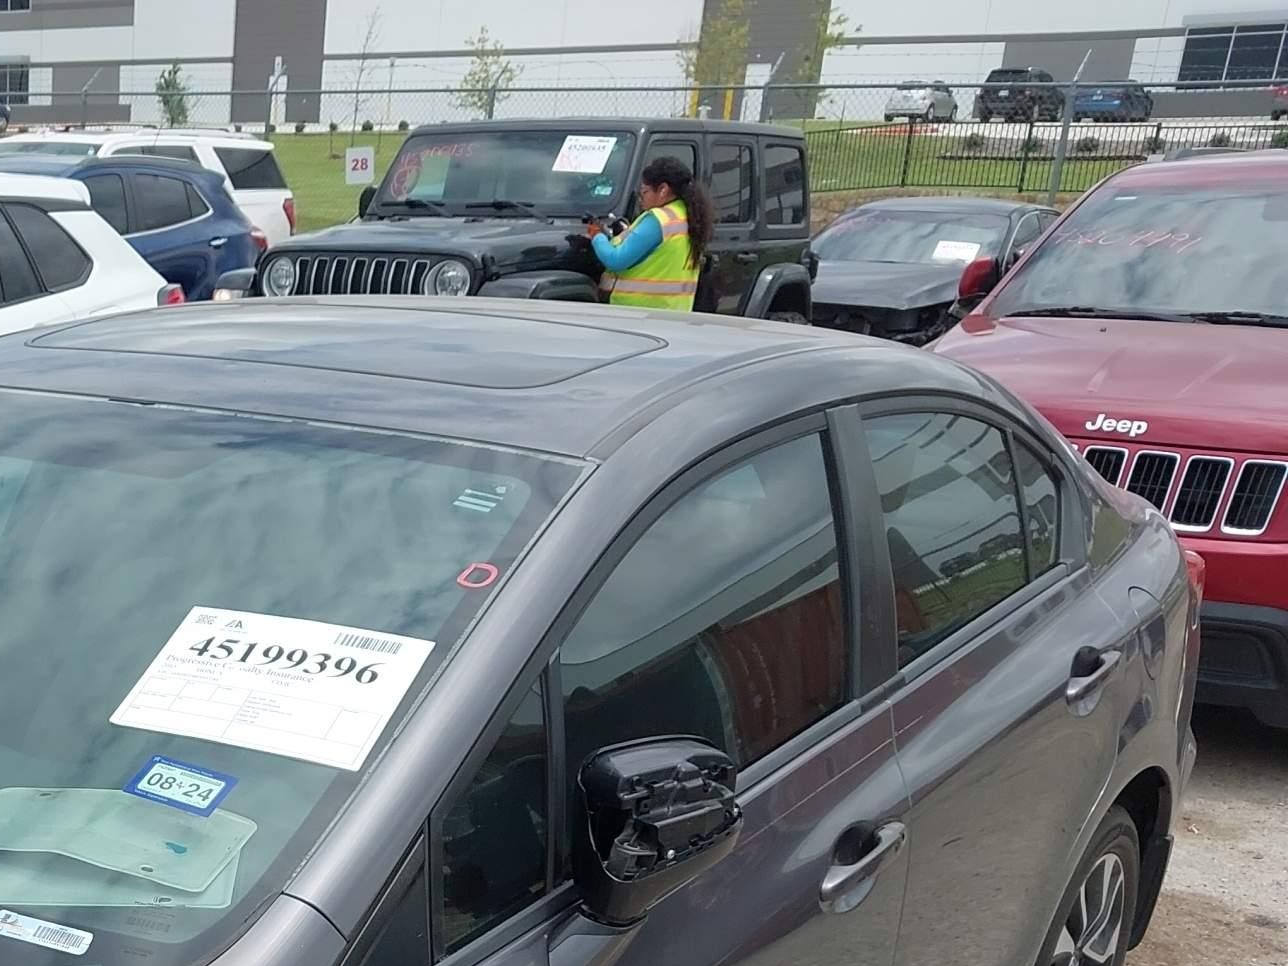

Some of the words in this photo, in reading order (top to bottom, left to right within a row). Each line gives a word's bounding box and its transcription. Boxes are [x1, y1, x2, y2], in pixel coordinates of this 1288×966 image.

[351, 158, 369, 171] 28
[1085, 413, 1148, 437] Jeep
[189, 636, 386, 684] 45199396
[266, 669, 314, 683] Insurance
[147, 773, 177, 790] 08
[182, 783, 214, 801] 24
